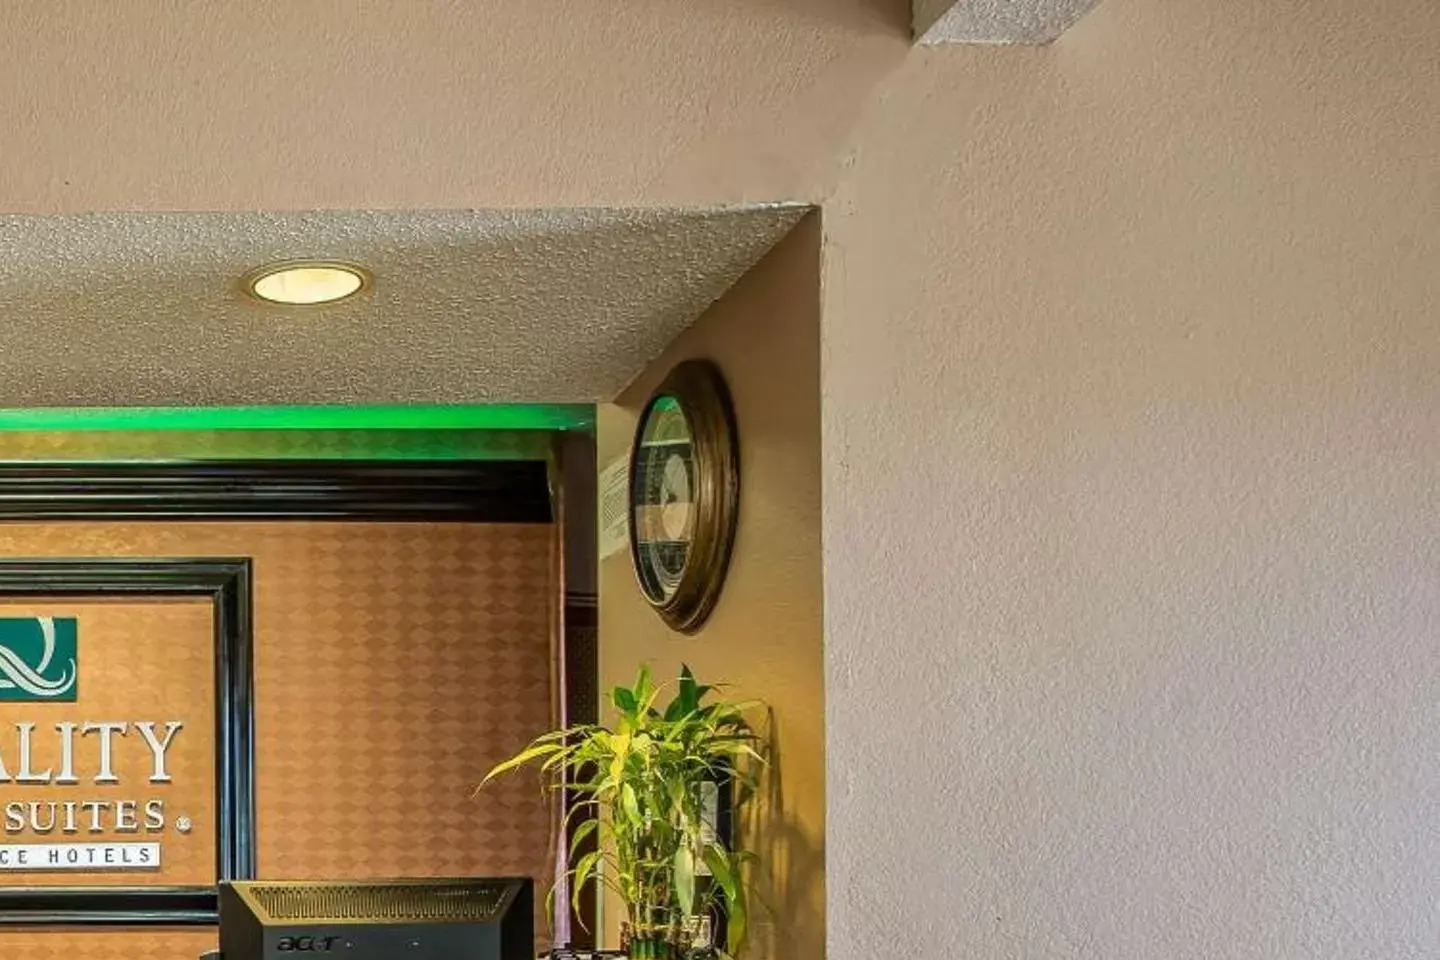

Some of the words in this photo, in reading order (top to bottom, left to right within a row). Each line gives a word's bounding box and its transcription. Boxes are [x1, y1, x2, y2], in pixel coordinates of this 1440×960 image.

[5, 800, 165, 833] SUITES
[48, 847, 151, 864] HOTELS
[277, 935, 342, 951] acer
